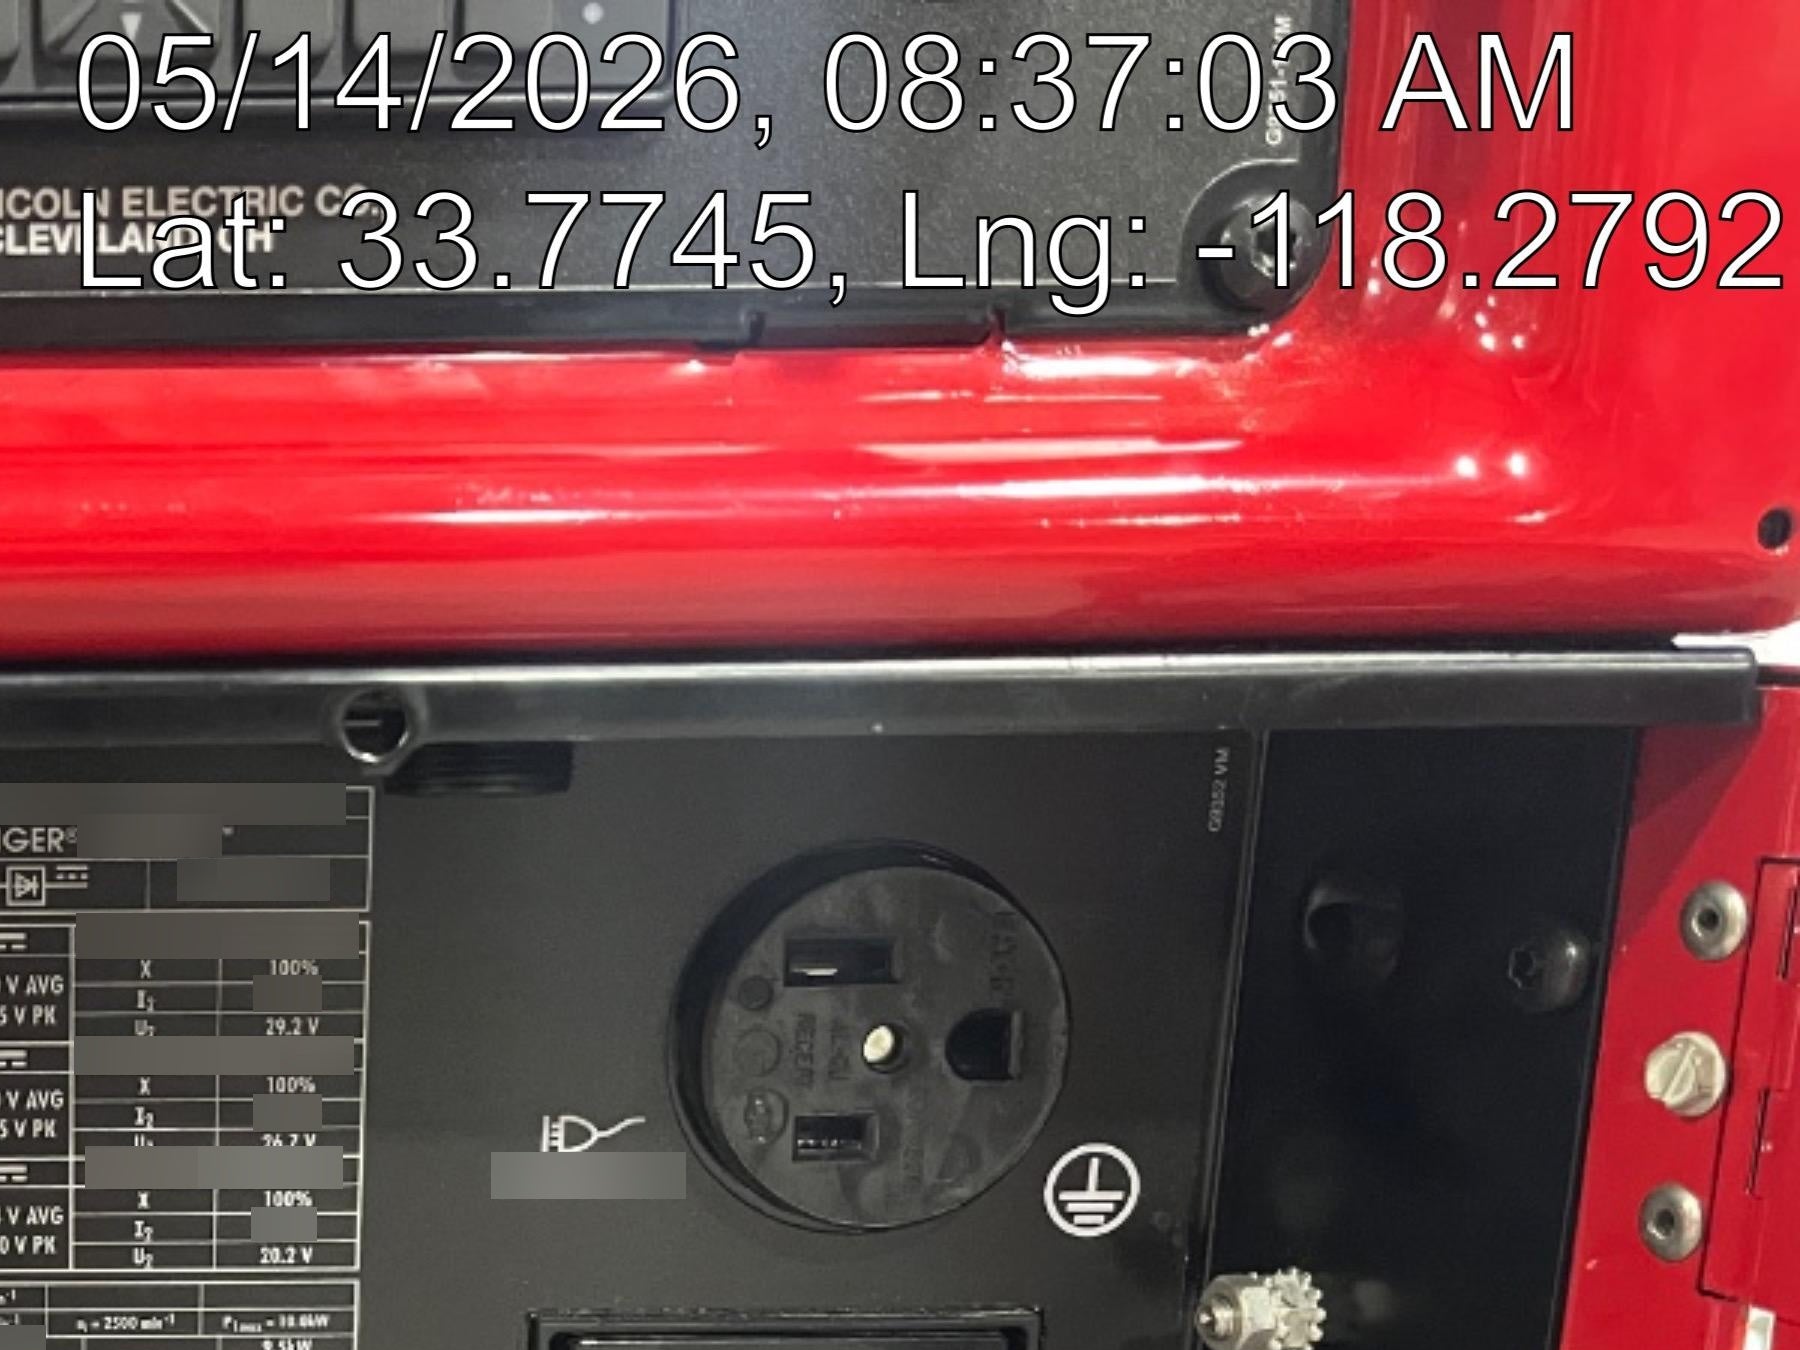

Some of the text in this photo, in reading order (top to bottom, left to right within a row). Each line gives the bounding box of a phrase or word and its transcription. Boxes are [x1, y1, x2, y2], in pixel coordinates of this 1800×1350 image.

[122, 185, 304, 218] ELECTRIC
[269, 959, 320, 976] 100%
[25, 974, 64, 996] AVG
[31, 1004, 56, 1026] PK
[265, 1015, 301, 1036] 29.2
[307, 1015, 321, 1036] V
[266, 1075, 317, 1094] 100%
[25, 1088, 64, 1111] AVG
[32, 1118, 57, 1139] PK
[264, 1189, 314, 1208] 100%
[26, 1205, 65, 1226] AVG
[32, 1235, 57, 1256] PK
[259, 1246, 297, 1265] 20.2
[301, 1246, 314, 1265] V
